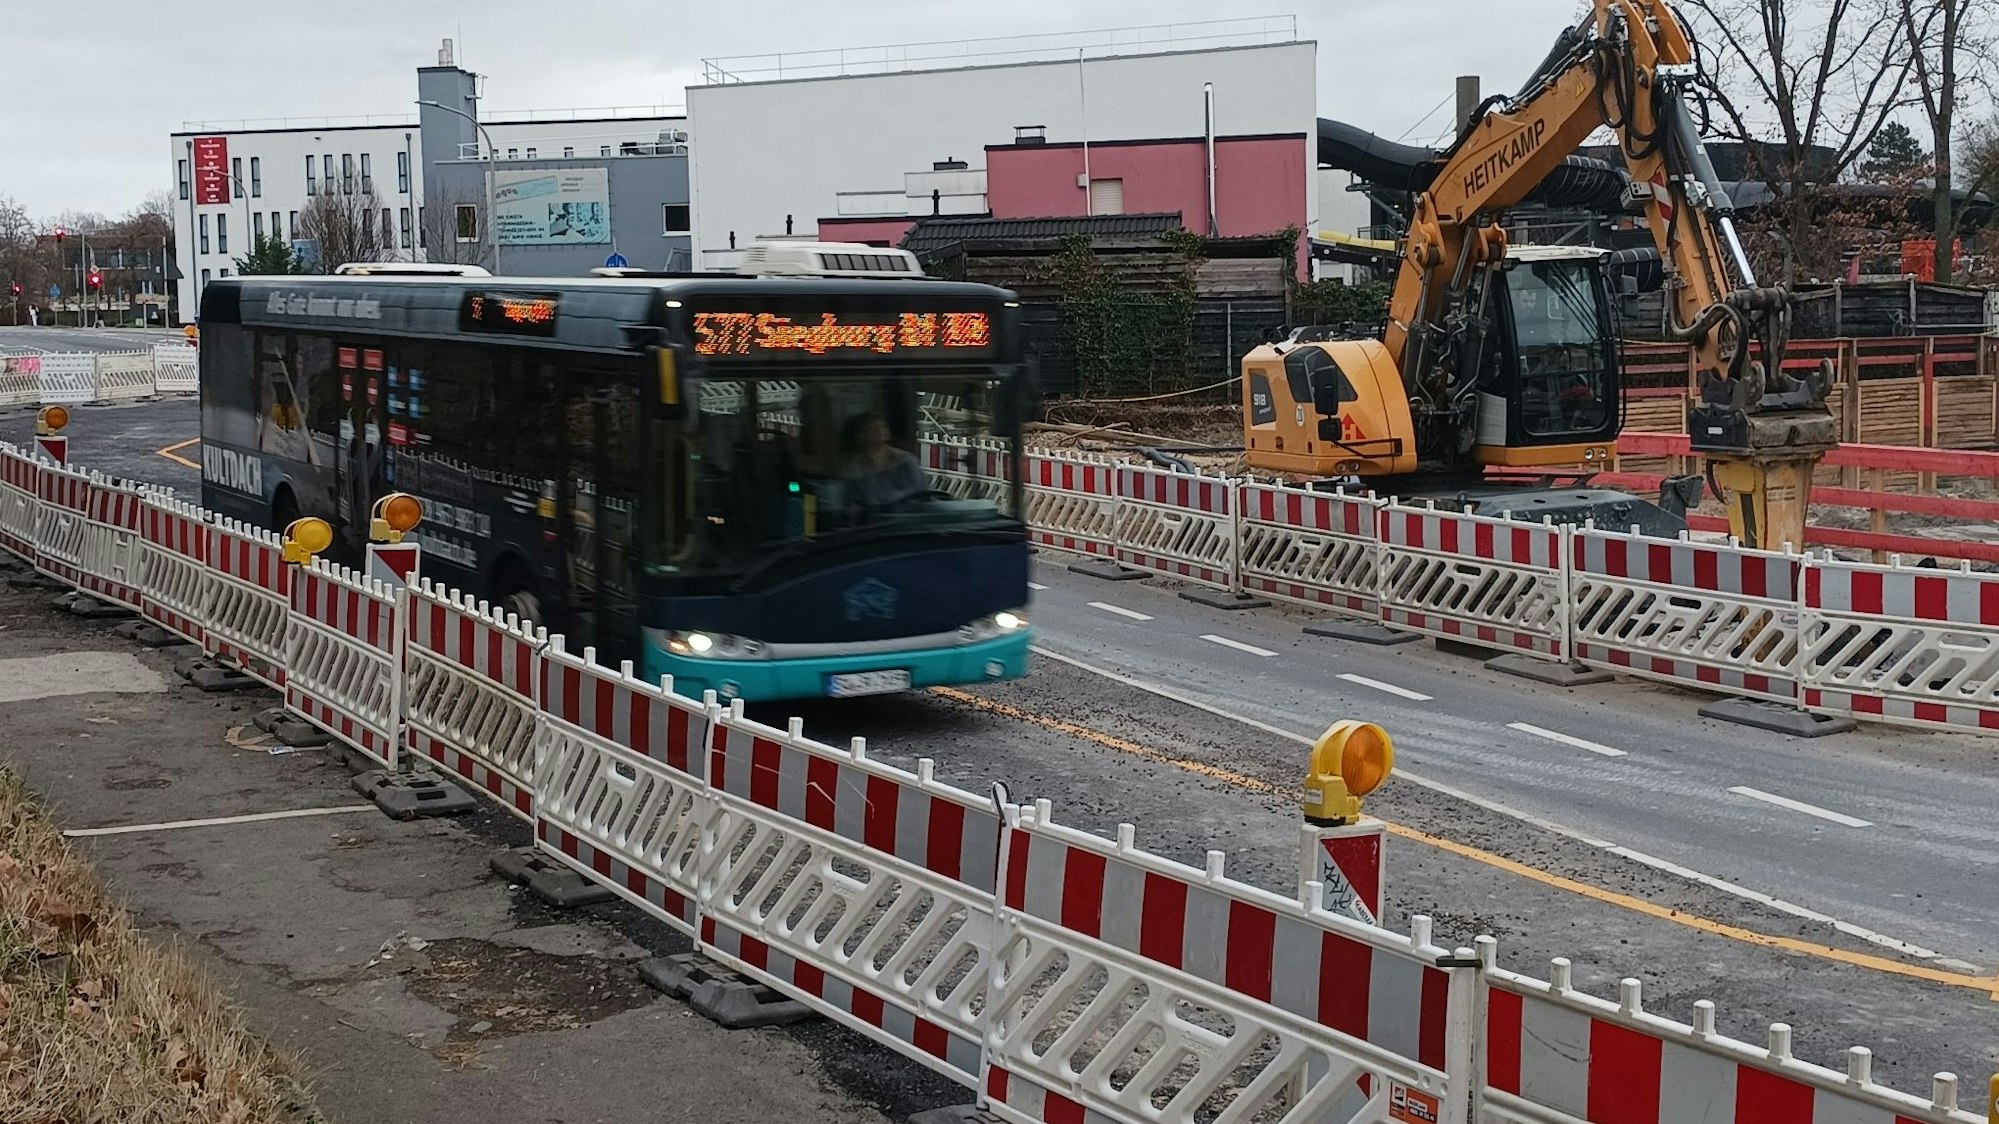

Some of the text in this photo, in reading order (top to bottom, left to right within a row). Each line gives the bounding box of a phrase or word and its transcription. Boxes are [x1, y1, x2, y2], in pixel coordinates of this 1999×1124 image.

[1464, 118, 1545, 199] HEITKAMP
[694, 313, 752, 354] 577
[754, 313, 896, 353] Siegburg
[203, 443, 263, 496] KULTDACH
